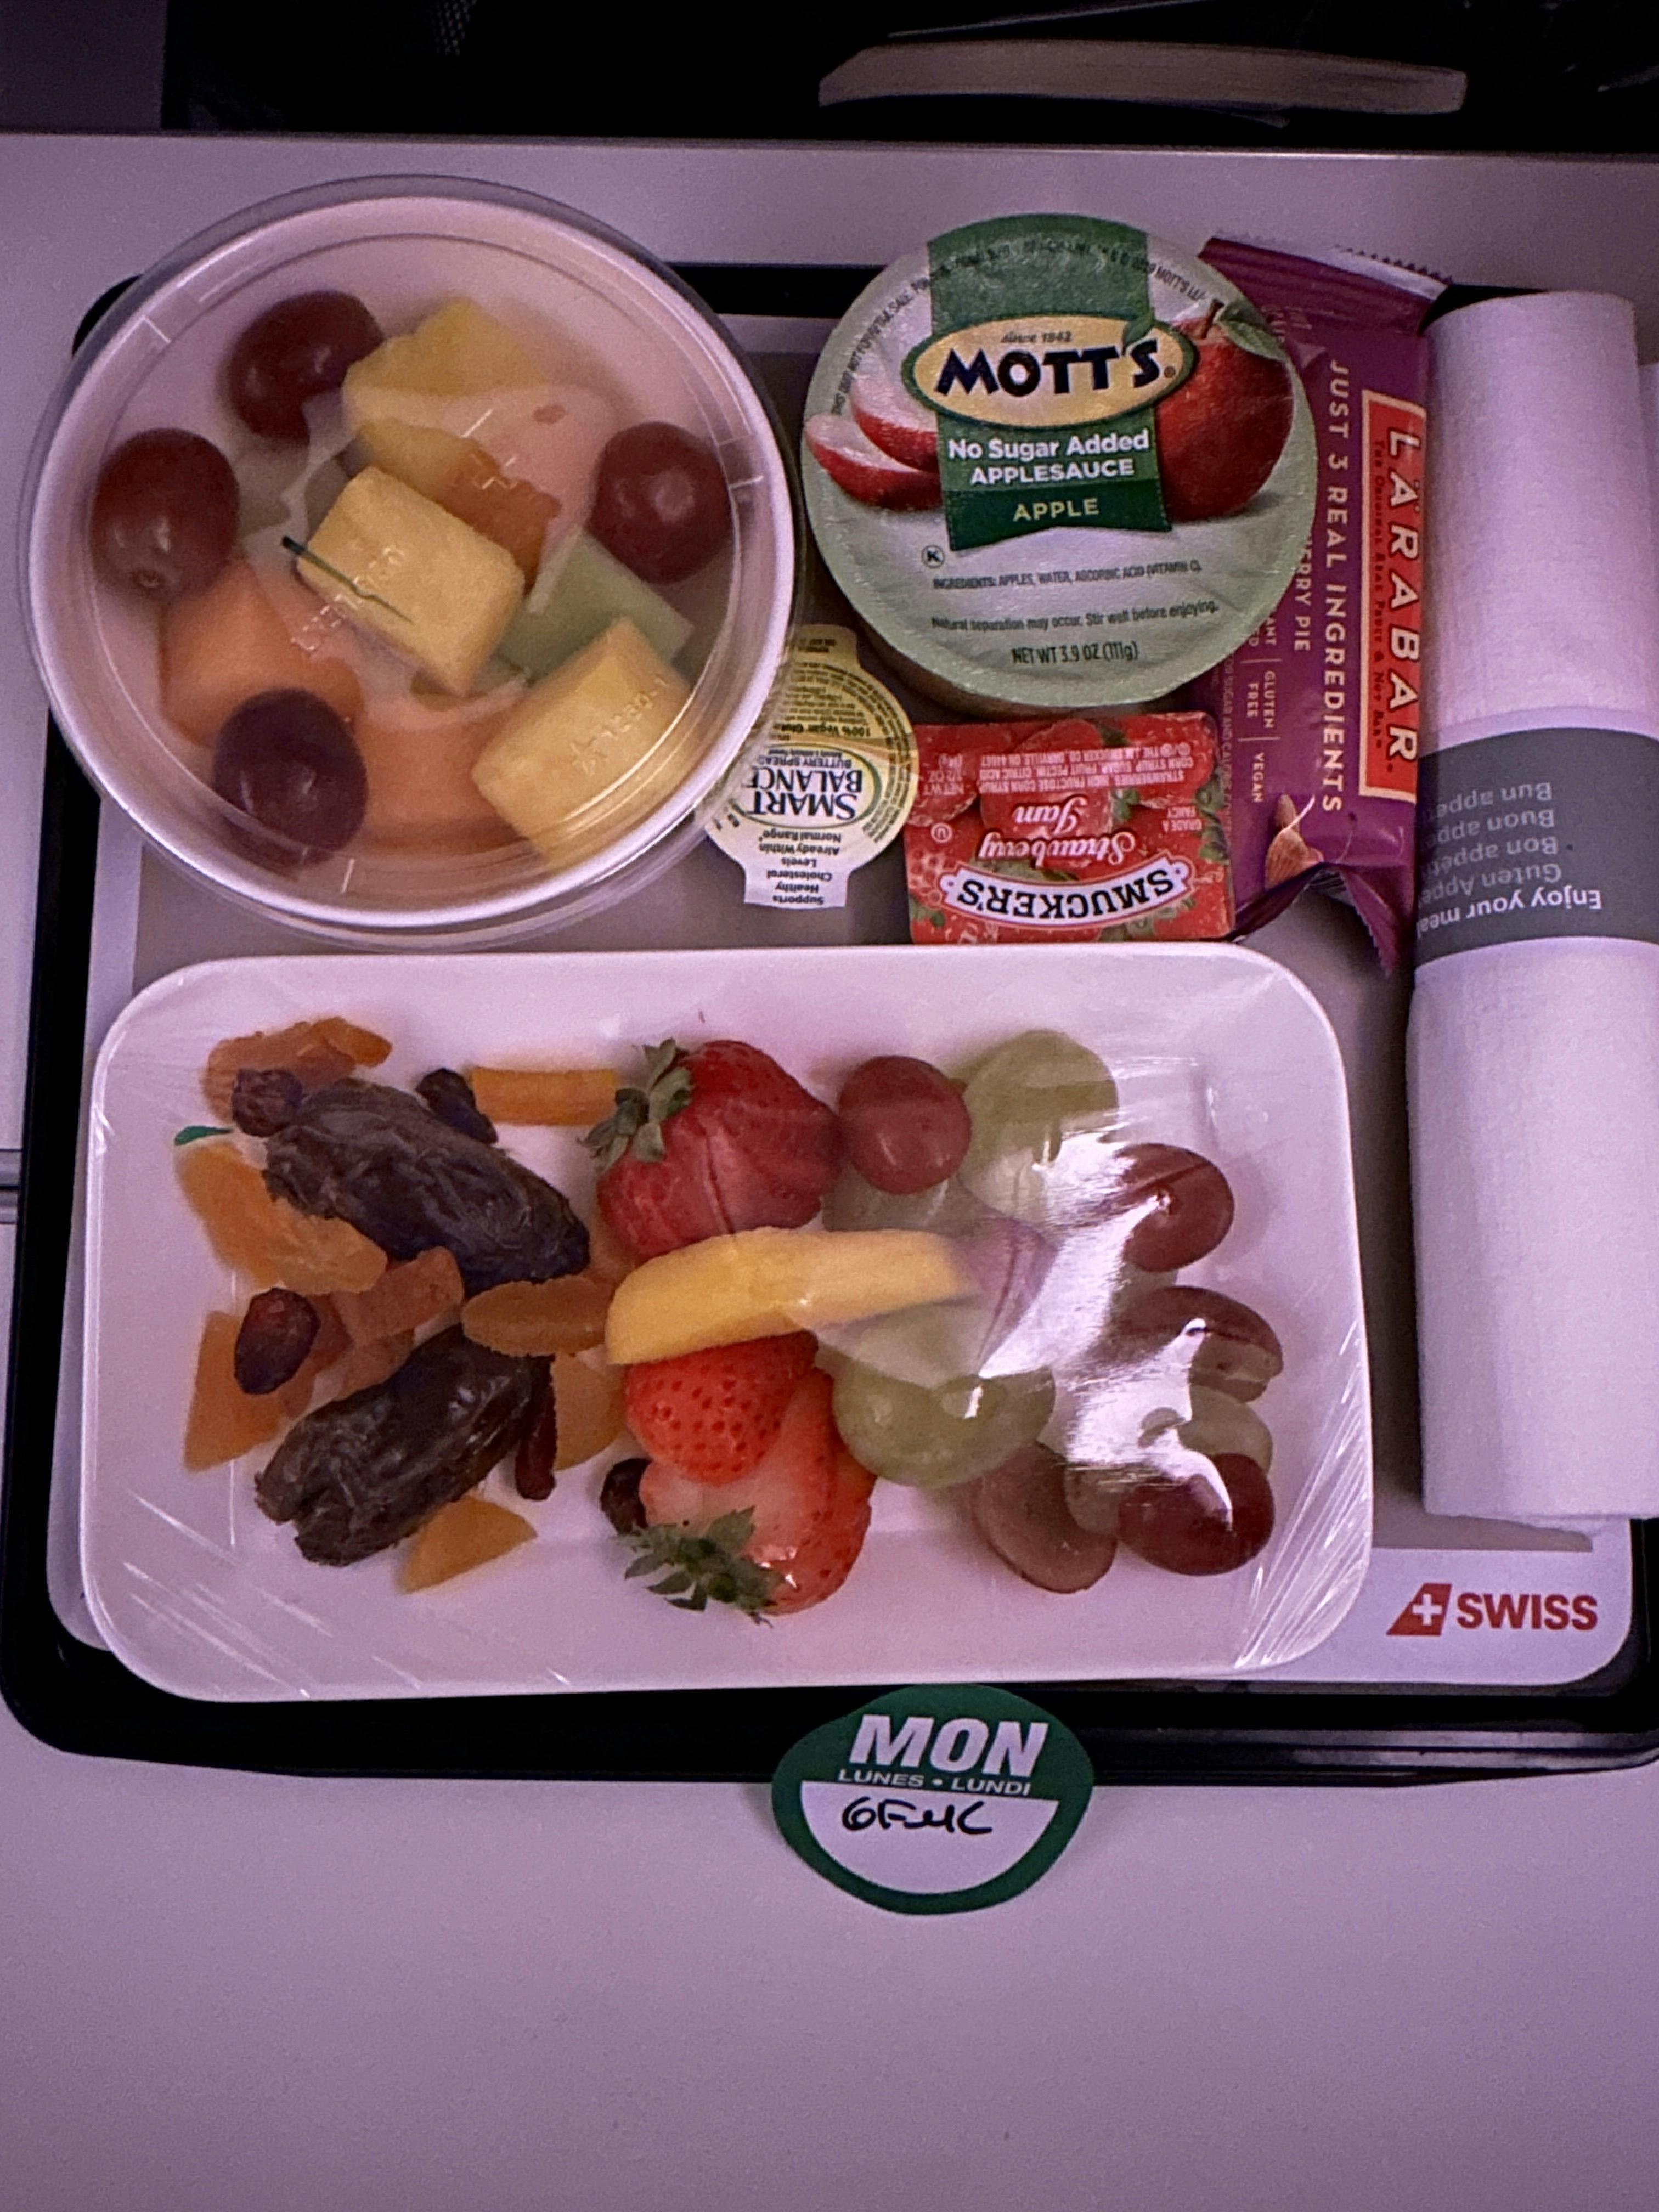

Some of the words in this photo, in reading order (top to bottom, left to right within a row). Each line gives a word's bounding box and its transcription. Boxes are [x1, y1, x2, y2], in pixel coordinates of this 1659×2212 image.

[1328, 360, 1350, 438] JUST
[947, 438, 982, 460] No
[988, 438, 1059, 461] Sugar
[1066, 428, 1149, 456] Added
[970, 459, 1134, 486] APPLESAUCE
[1328, 455, 1348, 470] 3
[1013, 498, 1099, 522] APPLE
[1326, 487, 1348, 568] REAL
[1389, 430, 1420, 763] LÄRABAR
[1028, 618, 1048, 631] may
[1132, 607, 1166, 621] before
[1294, 615, 1311, 651] PIE
[1012, 647, 1035, 664] NET
[1037, 646, 1057, 664] WT
[1061, 646, 1079, 662] 3.9
[1082, 644, 1101, 660] OZ
[1247, 682, 1259, 719] FREE
[1263, 670, 1276, 729] GLUTEN
[1322, 584, 1347, 812] INGREDIENTS
[1251, 753, 1265, 804] VEGAN
[1501, 781, 1553, 802] Bun
[748, 791, 857, 821] SMART
[1013, 796, 1087, 833] Jam
[1487, 809, 1555, 831] Buon
[759, 843, 795, 853] Within
[797, 844, 840, 856] Already
[799, 831, 842, 843] Normal
[978, 831, 1136, 869] Strawberry
[1506, 836, 1558, 855] Bon
[781, 857, 816, 867] Levels
[1482, 863, 1562, 888] Guten
[766, 870, 832, 882] Cholesterol
[776, 881, 819, 893] Healthy
[772, 894, 824, 904] Supports
[957, 868, 1175, 919] SMUCKER'S
[1466, 888, 1525, 919] your
[1531, 885, 1602, 910] Enjoy
[1457, 1592, 1599, 1631] SWISS
[848, 1714, 1048, 1778] MON
[837, 1769, 925, 1787] LUNES
[950, 1778, 1031, 1796] LUNDI
